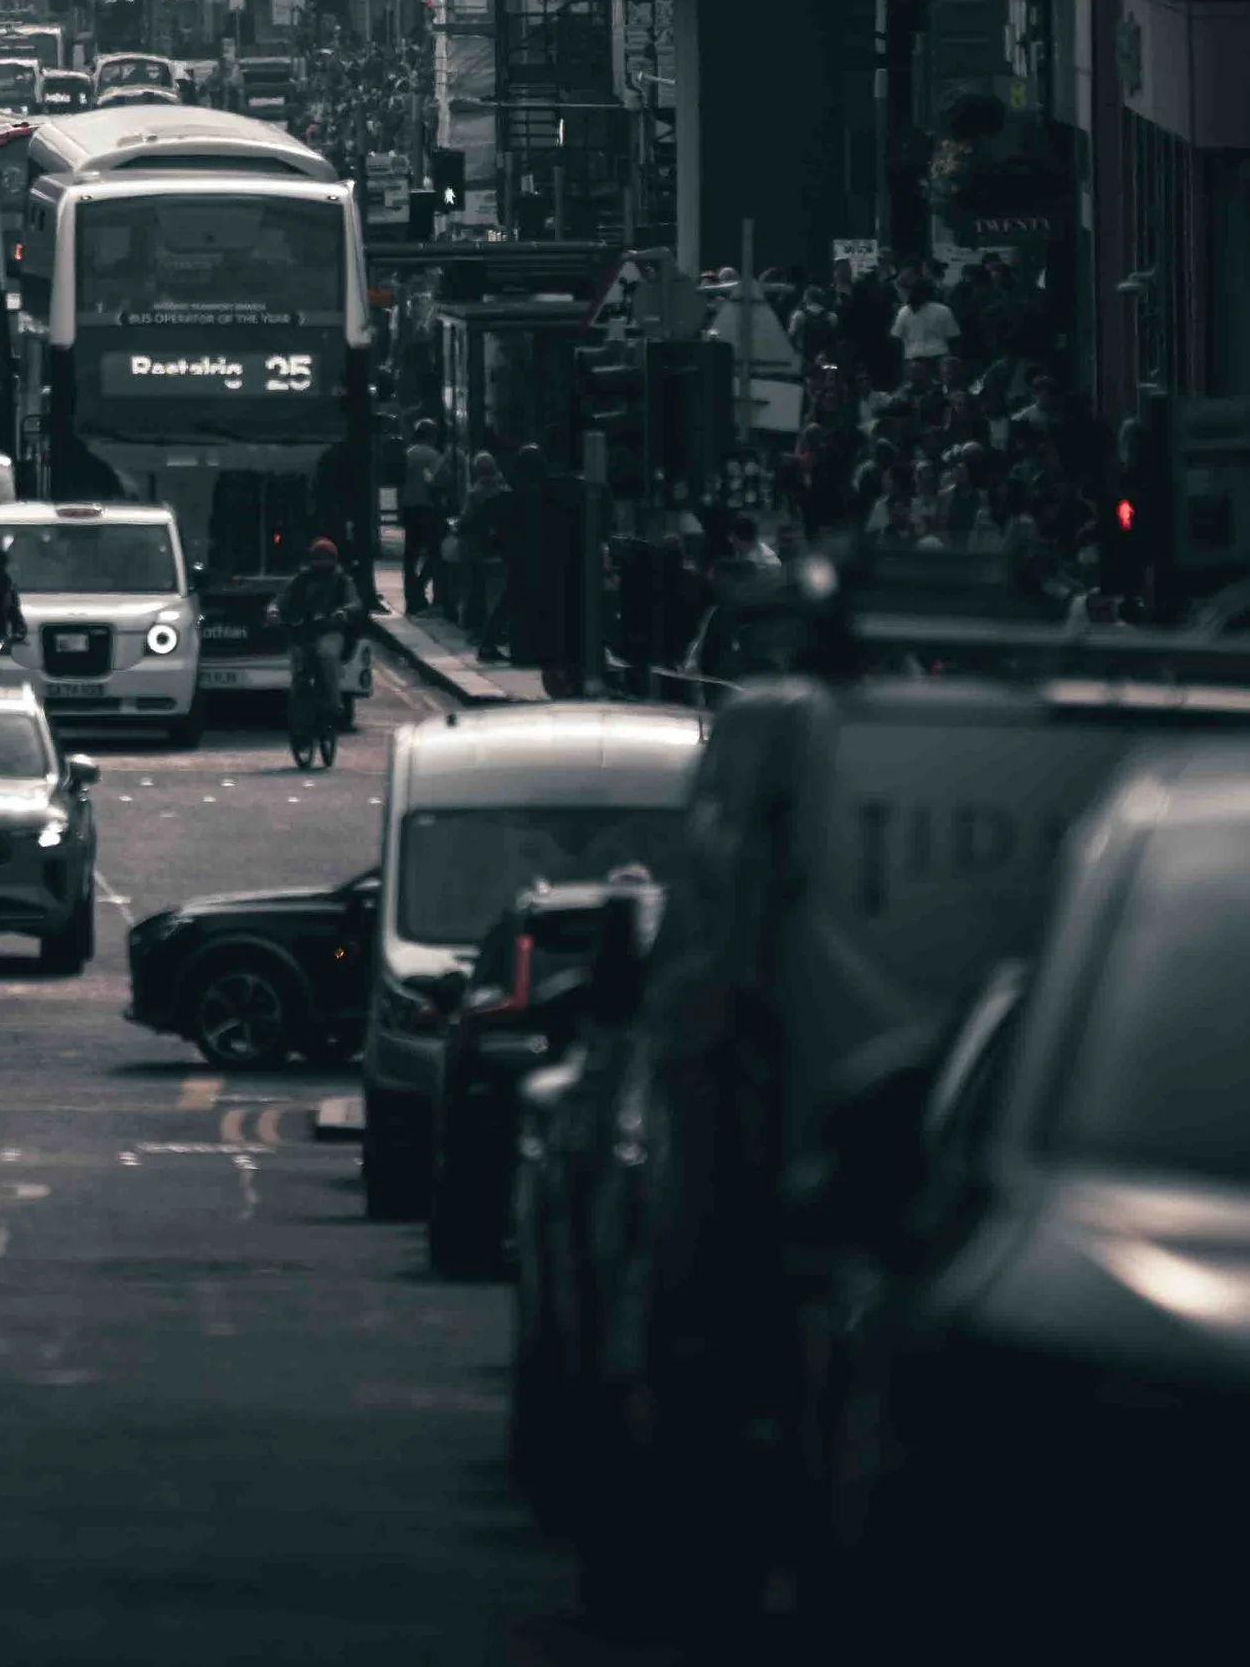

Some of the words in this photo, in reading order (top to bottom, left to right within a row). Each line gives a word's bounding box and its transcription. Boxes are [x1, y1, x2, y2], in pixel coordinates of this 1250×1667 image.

[154, 313, 214, 325] OPERATOR
[218, 313, 233, 325] OF
[236, 313, 258, 325] THE
[265, 354, 312, 391] 25
